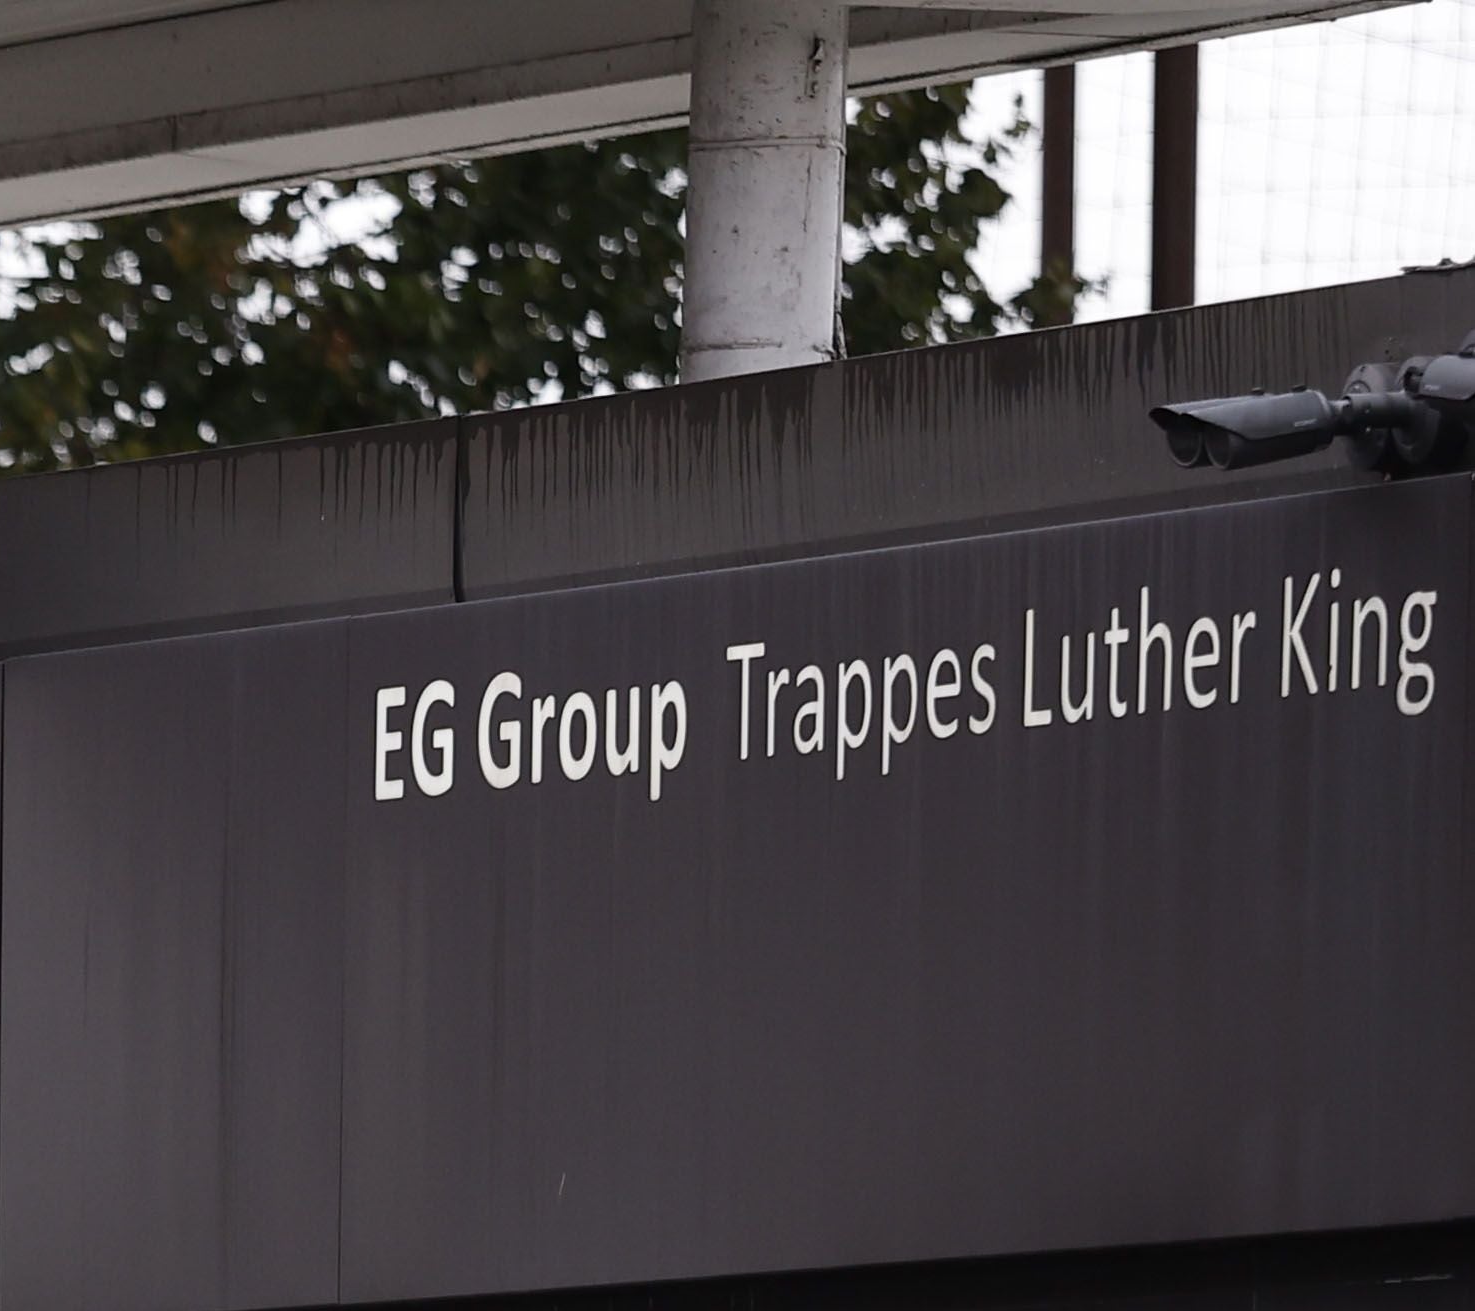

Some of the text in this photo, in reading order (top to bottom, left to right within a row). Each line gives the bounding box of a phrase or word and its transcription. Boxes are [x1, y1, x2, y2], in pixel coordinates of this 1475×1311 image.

[375, 567, 1438, 802] EG Group Trappes Luther King
